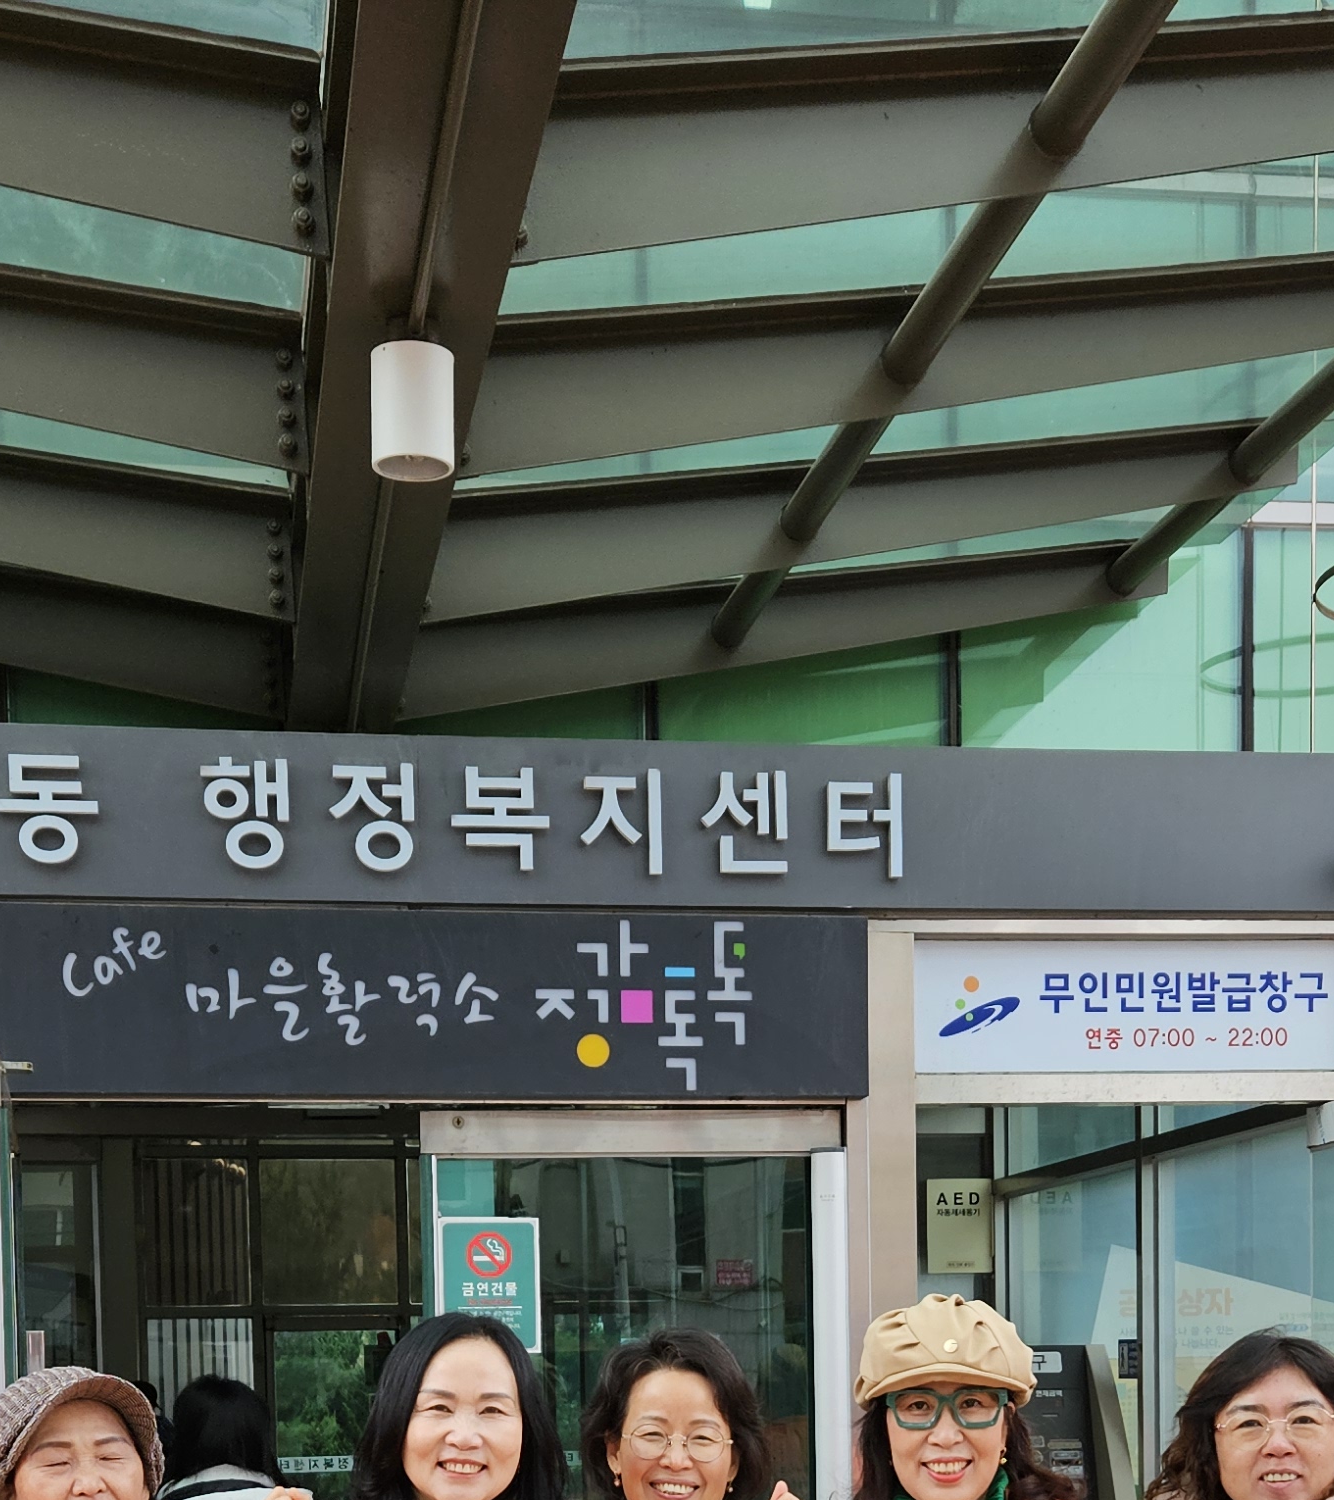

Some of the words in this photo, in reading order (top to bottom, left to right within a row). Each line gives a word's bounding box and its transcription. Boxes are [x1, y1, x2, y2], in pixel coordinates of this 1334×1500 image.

[200, 756, 903, 879] 행정복지센터
[62, 927, 166, 996] Cafe
[185, 952, 499, 1046] 마을활력소
[1039, 971, 1328, 1013] 무인민원발급창구
[1085, 1028, 1123, 1050] 연중
[1133, 1028, 1195, 1047] 07:00
[1228, 1027, 1288, 1047] 22:00
[462, 1282, 517, 1297] 금연건물
